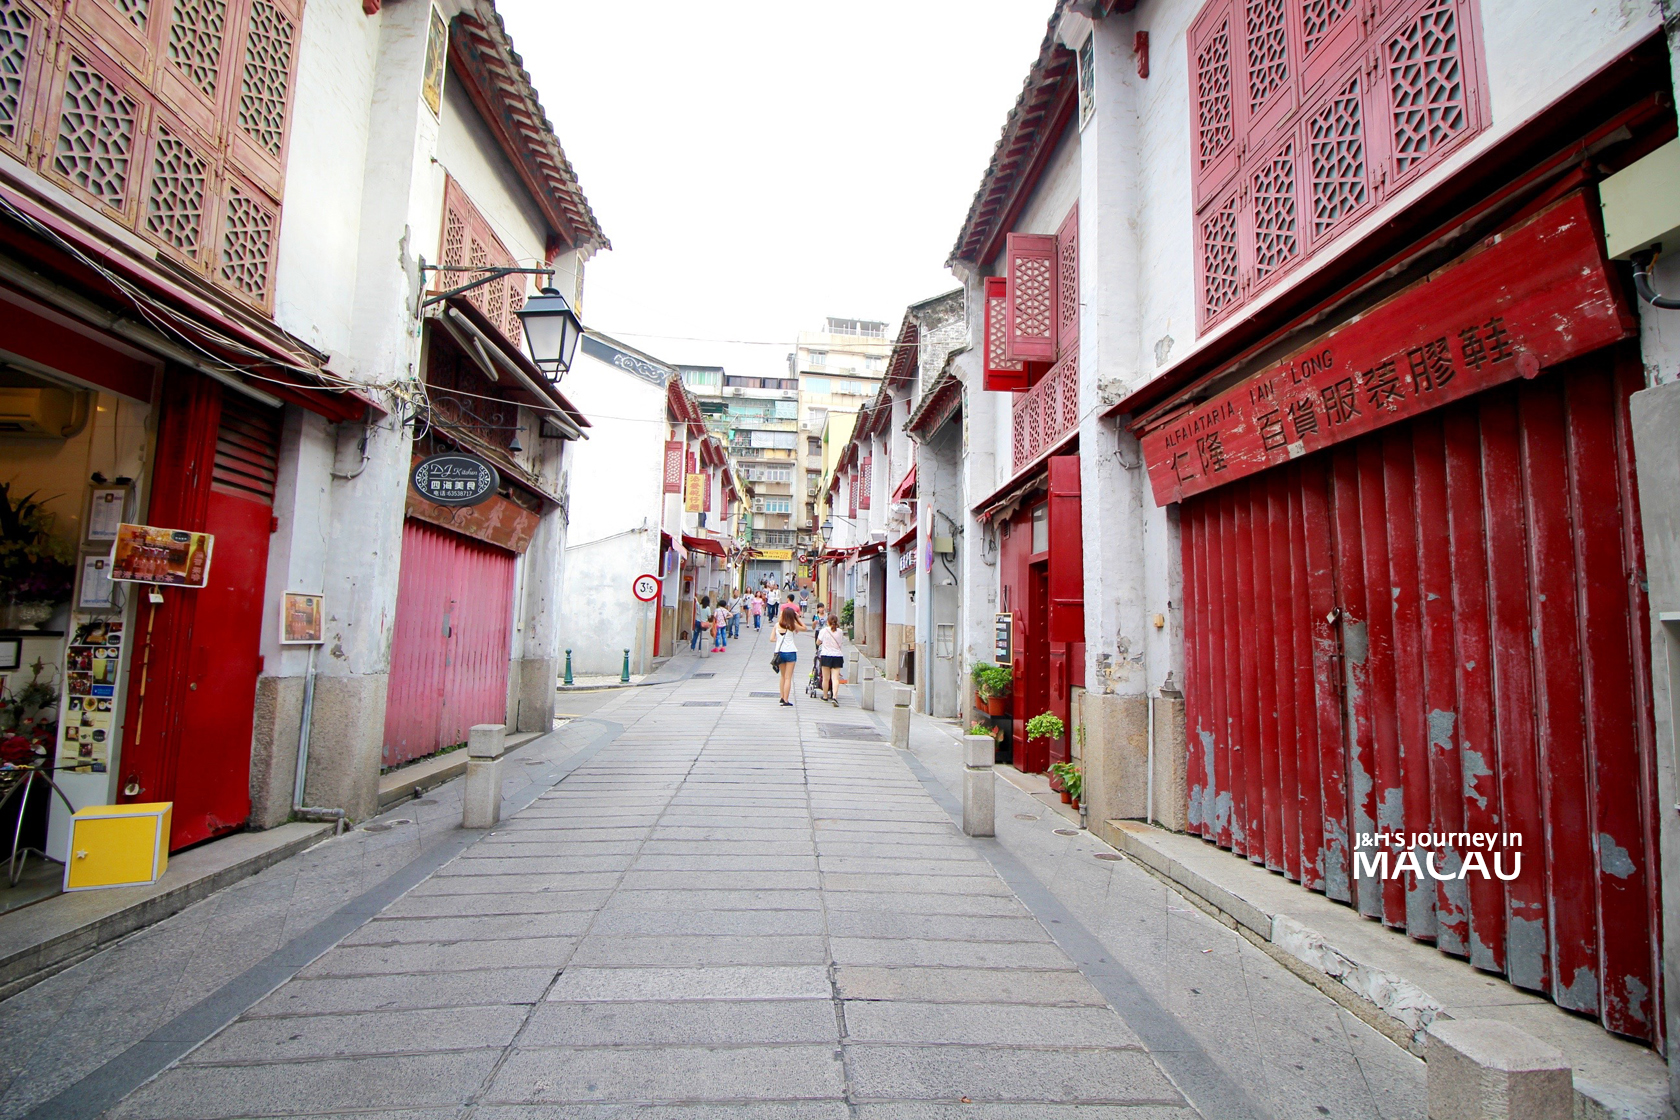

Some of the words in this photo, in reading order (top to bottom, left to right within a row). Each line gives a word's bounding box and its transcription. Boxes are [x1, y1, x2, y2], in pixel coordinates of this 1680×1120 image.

[1165, 401, 1235, 449] ALFAIATARIA
[1250, 380, 1275, 406] IAN
[1290, 349, 1333, 386] LONG
[1171, 430, 1228, 487] 仁隆
[1256, 316, 1514, 453] 百貨服裝膠鞋
[430, 463, 453, 478] DJ
[430, 480, 476, 491] 四海美食
